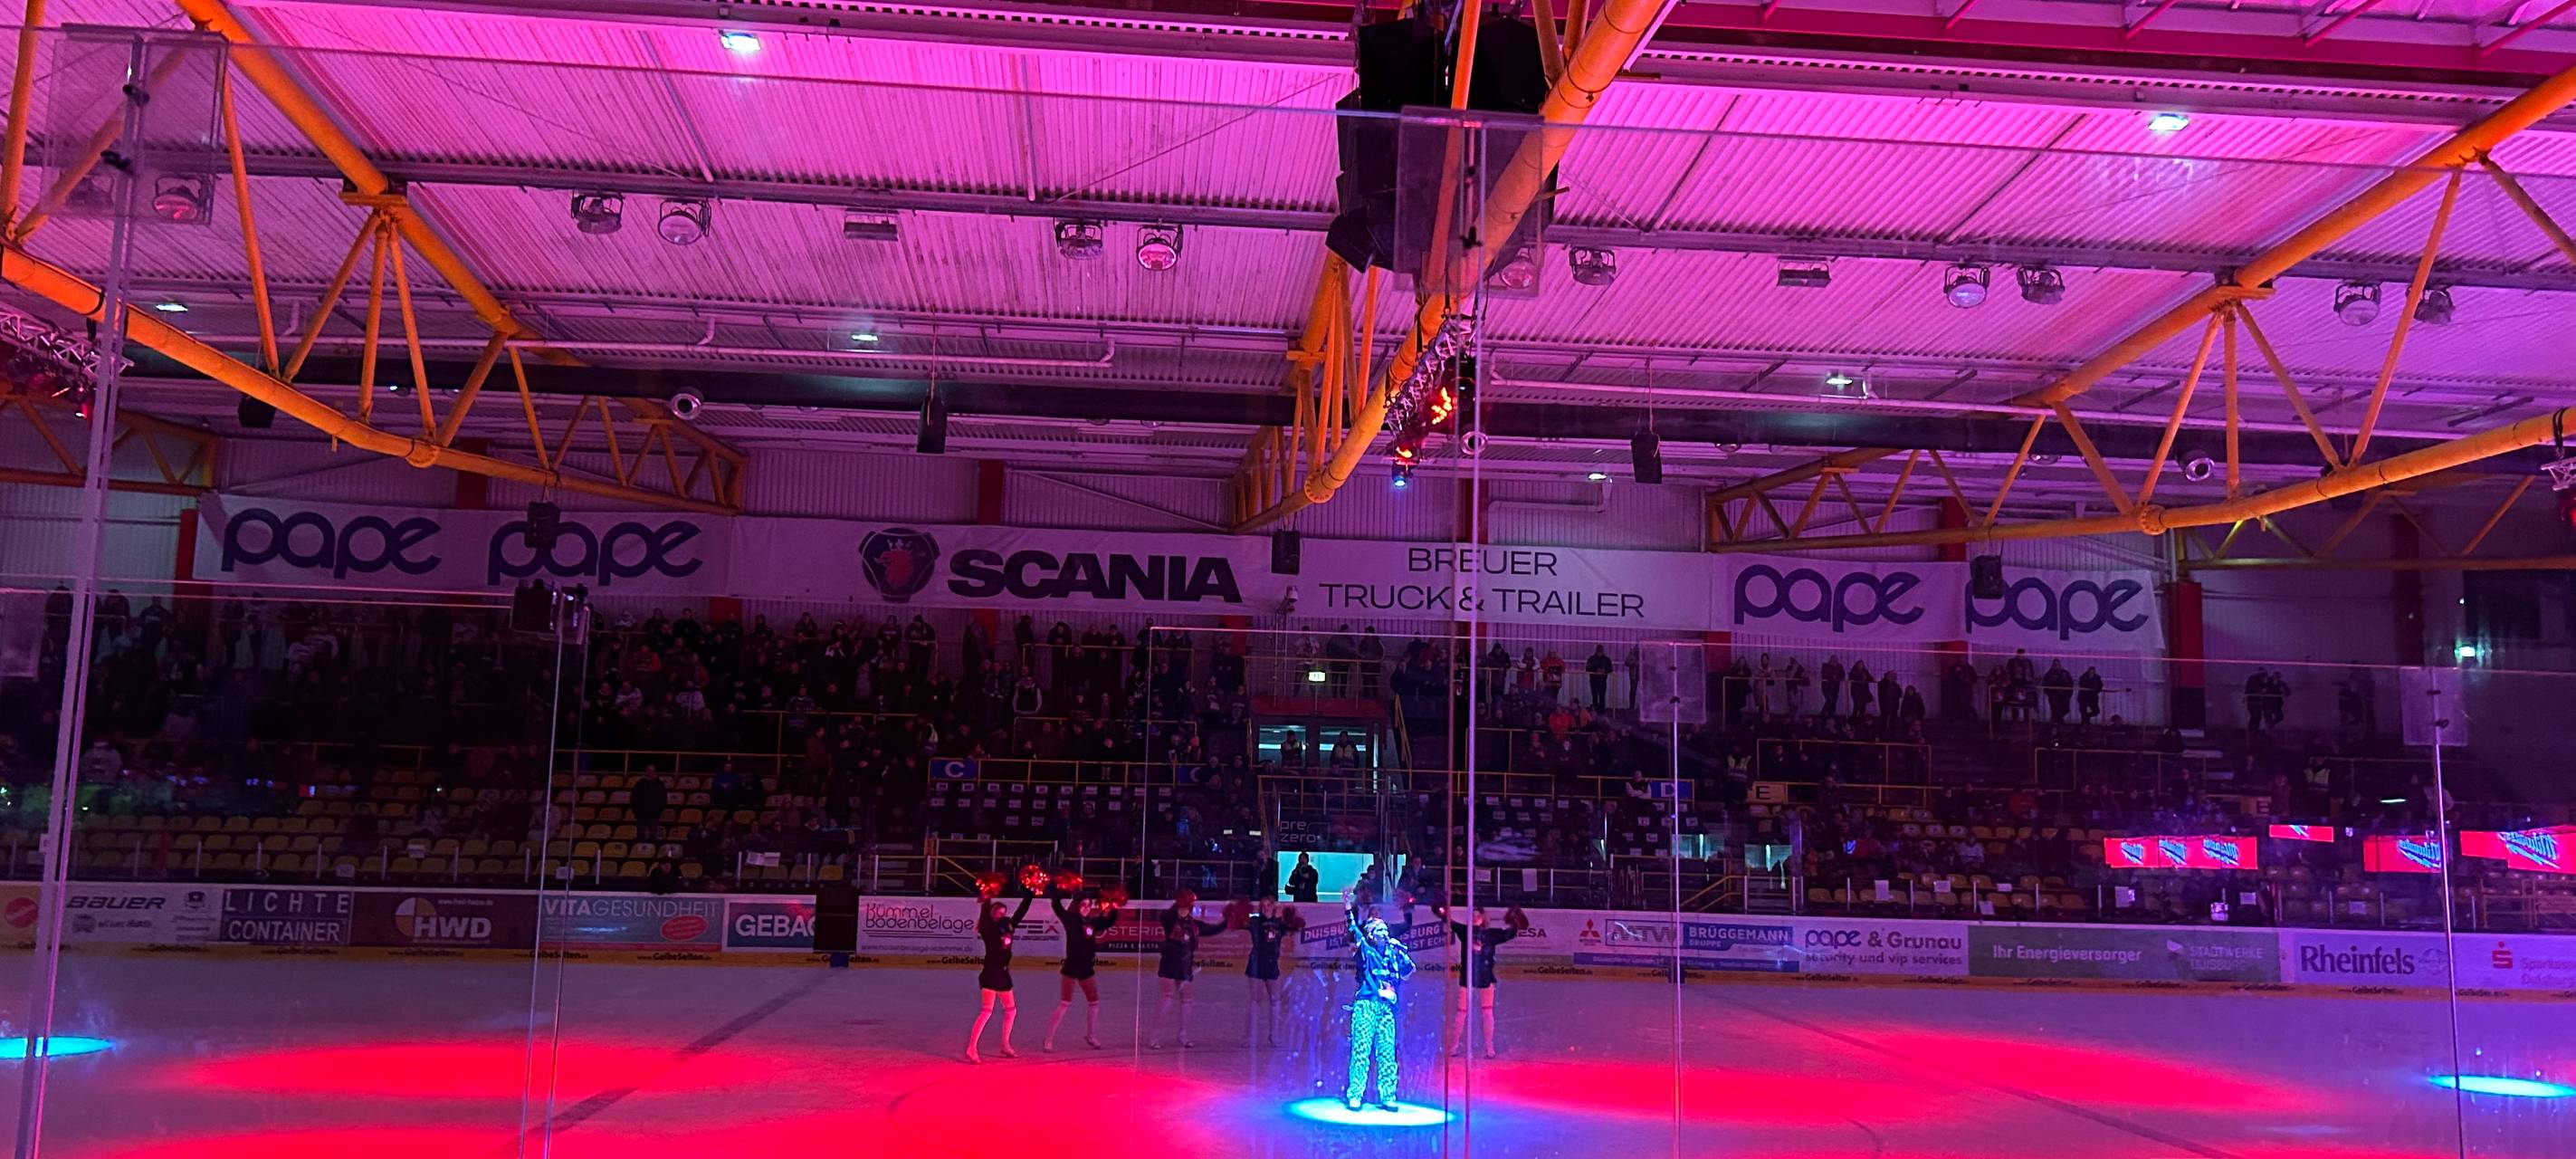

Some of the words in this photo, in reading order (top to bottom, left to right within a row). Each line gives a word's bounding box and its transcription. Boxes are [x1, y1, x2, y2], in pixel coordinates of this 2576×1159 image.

[222, 509, 441, 579] pape
[488, 520, 702, 585] pape
[1408, 548, 1557, 576] BREUER
[947, 549, 1243, 603] SCANIA
[1319, 583, 1453, 609] TRUCK
[1458, 586, 1484, 611] &
[1492, 588, 1644, 618] TRAILER
[1734, 564, 1924, 632] pape
[1965, 577, 2149, 641] pape
[944, 761, 965, 778] C
[1661, 782, 1675, 797] D
[1756, 786, 1770, 800] E
[1279, 820, 1307, 832] pre
[1280, 833, 1316, 843] zero
[224, 891, 350, 914] LICHTE
[544, 899, 718, 917] VITAGESUNDHEIT
[228, 920, 340, 942] CONTAINER
[414, 916, 492, 938] HWD
[735, 914, 815, 937] GEBA
[1304, 924, 1347, 940] DUISBU
[1402, 924, 1440, 940] SBURG
[1689, 924, 1789, 942] BRÜGGEMANN
[1428, 935, 1445, 946] ECH
[1689, 939, 1722, 948] GRUPPE
[1805, 930, 1861, 949] pape
[1867, 931, 1884, 948] &
[1887, 932, 1961, 950] Grunau
[1806, 953, 1855, 965] security
[1859, 953, 1884, 963] und
[1889, 953, 1908, 966] vip
[1912, 954, 1962, 964] services
[1993, 944, 2013, 960] Ihr
[2017, 945, 2142, 964] Energieversorger
[2301, 944, 2415, 975] Rheinfels
